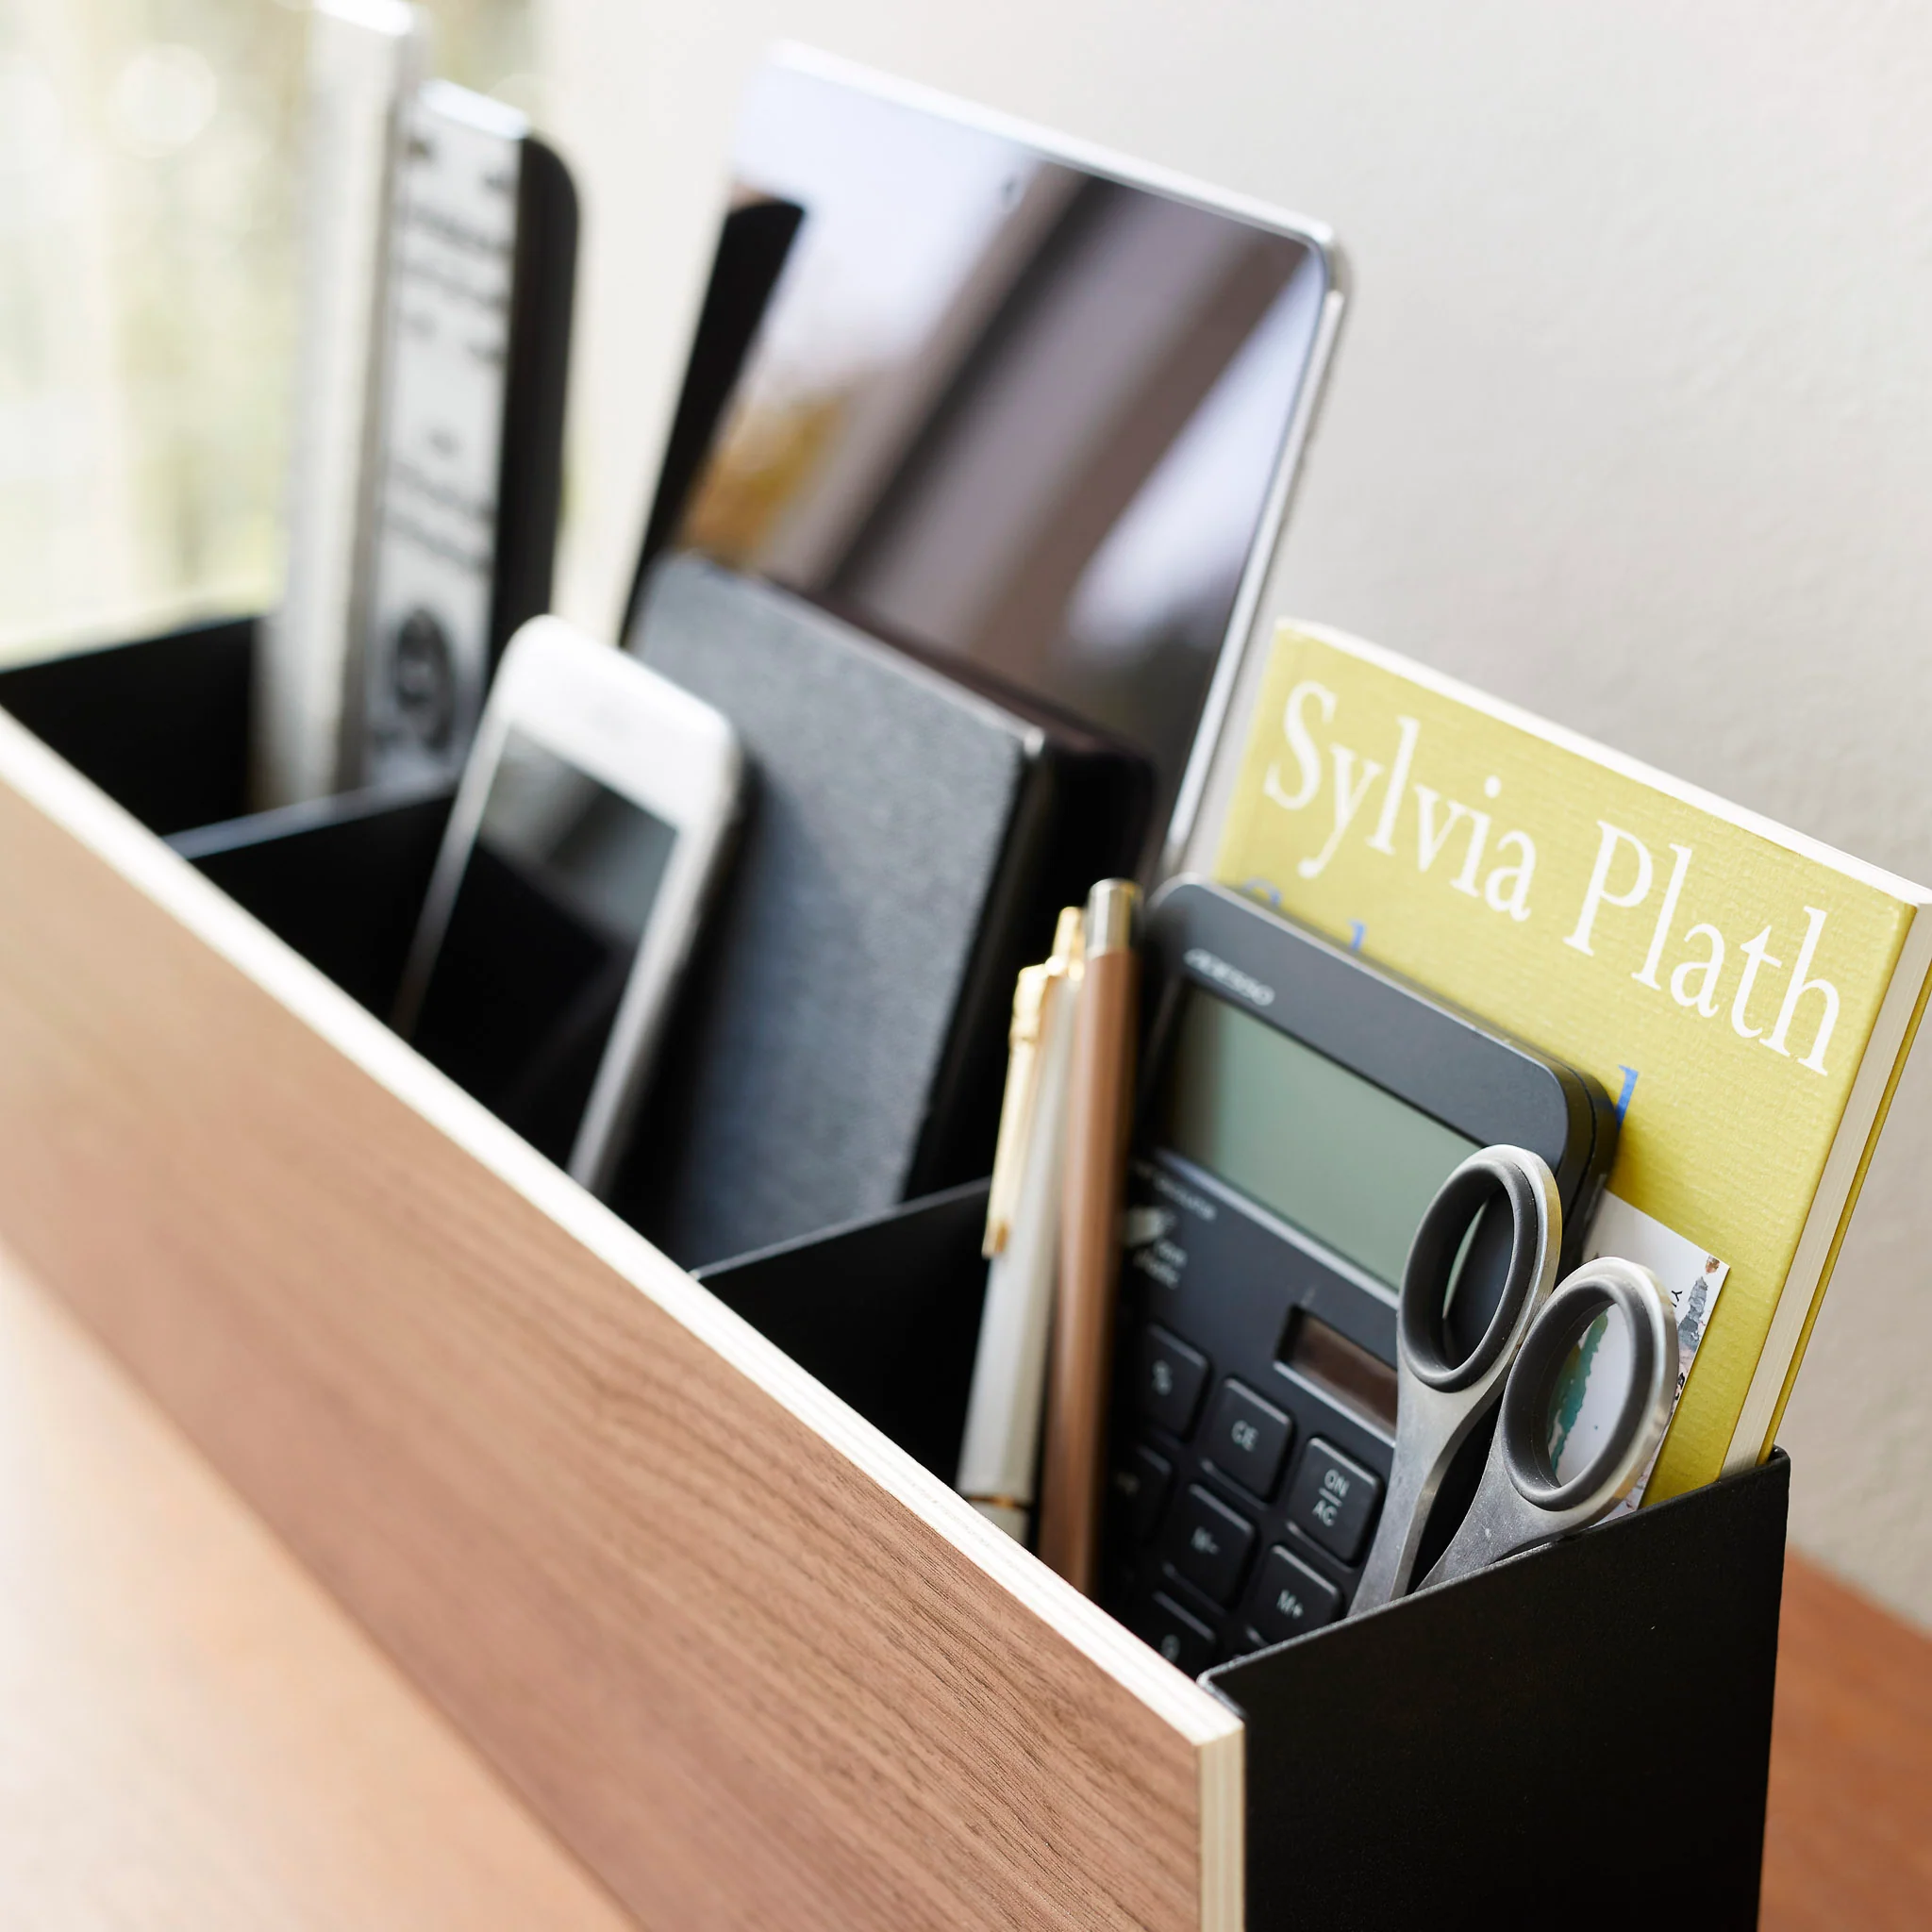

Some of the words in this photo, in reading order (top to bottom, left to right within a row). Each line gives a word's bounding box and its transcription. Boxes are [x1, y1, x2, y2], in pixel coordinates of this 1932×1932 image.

[1264, 679, 1537, 923] Sylvia
[1563, 820, 1845, 1076] Plath
[1324, 1469, 1350, 1496] ON
[1312, 1499, 1338, 1526] AC
